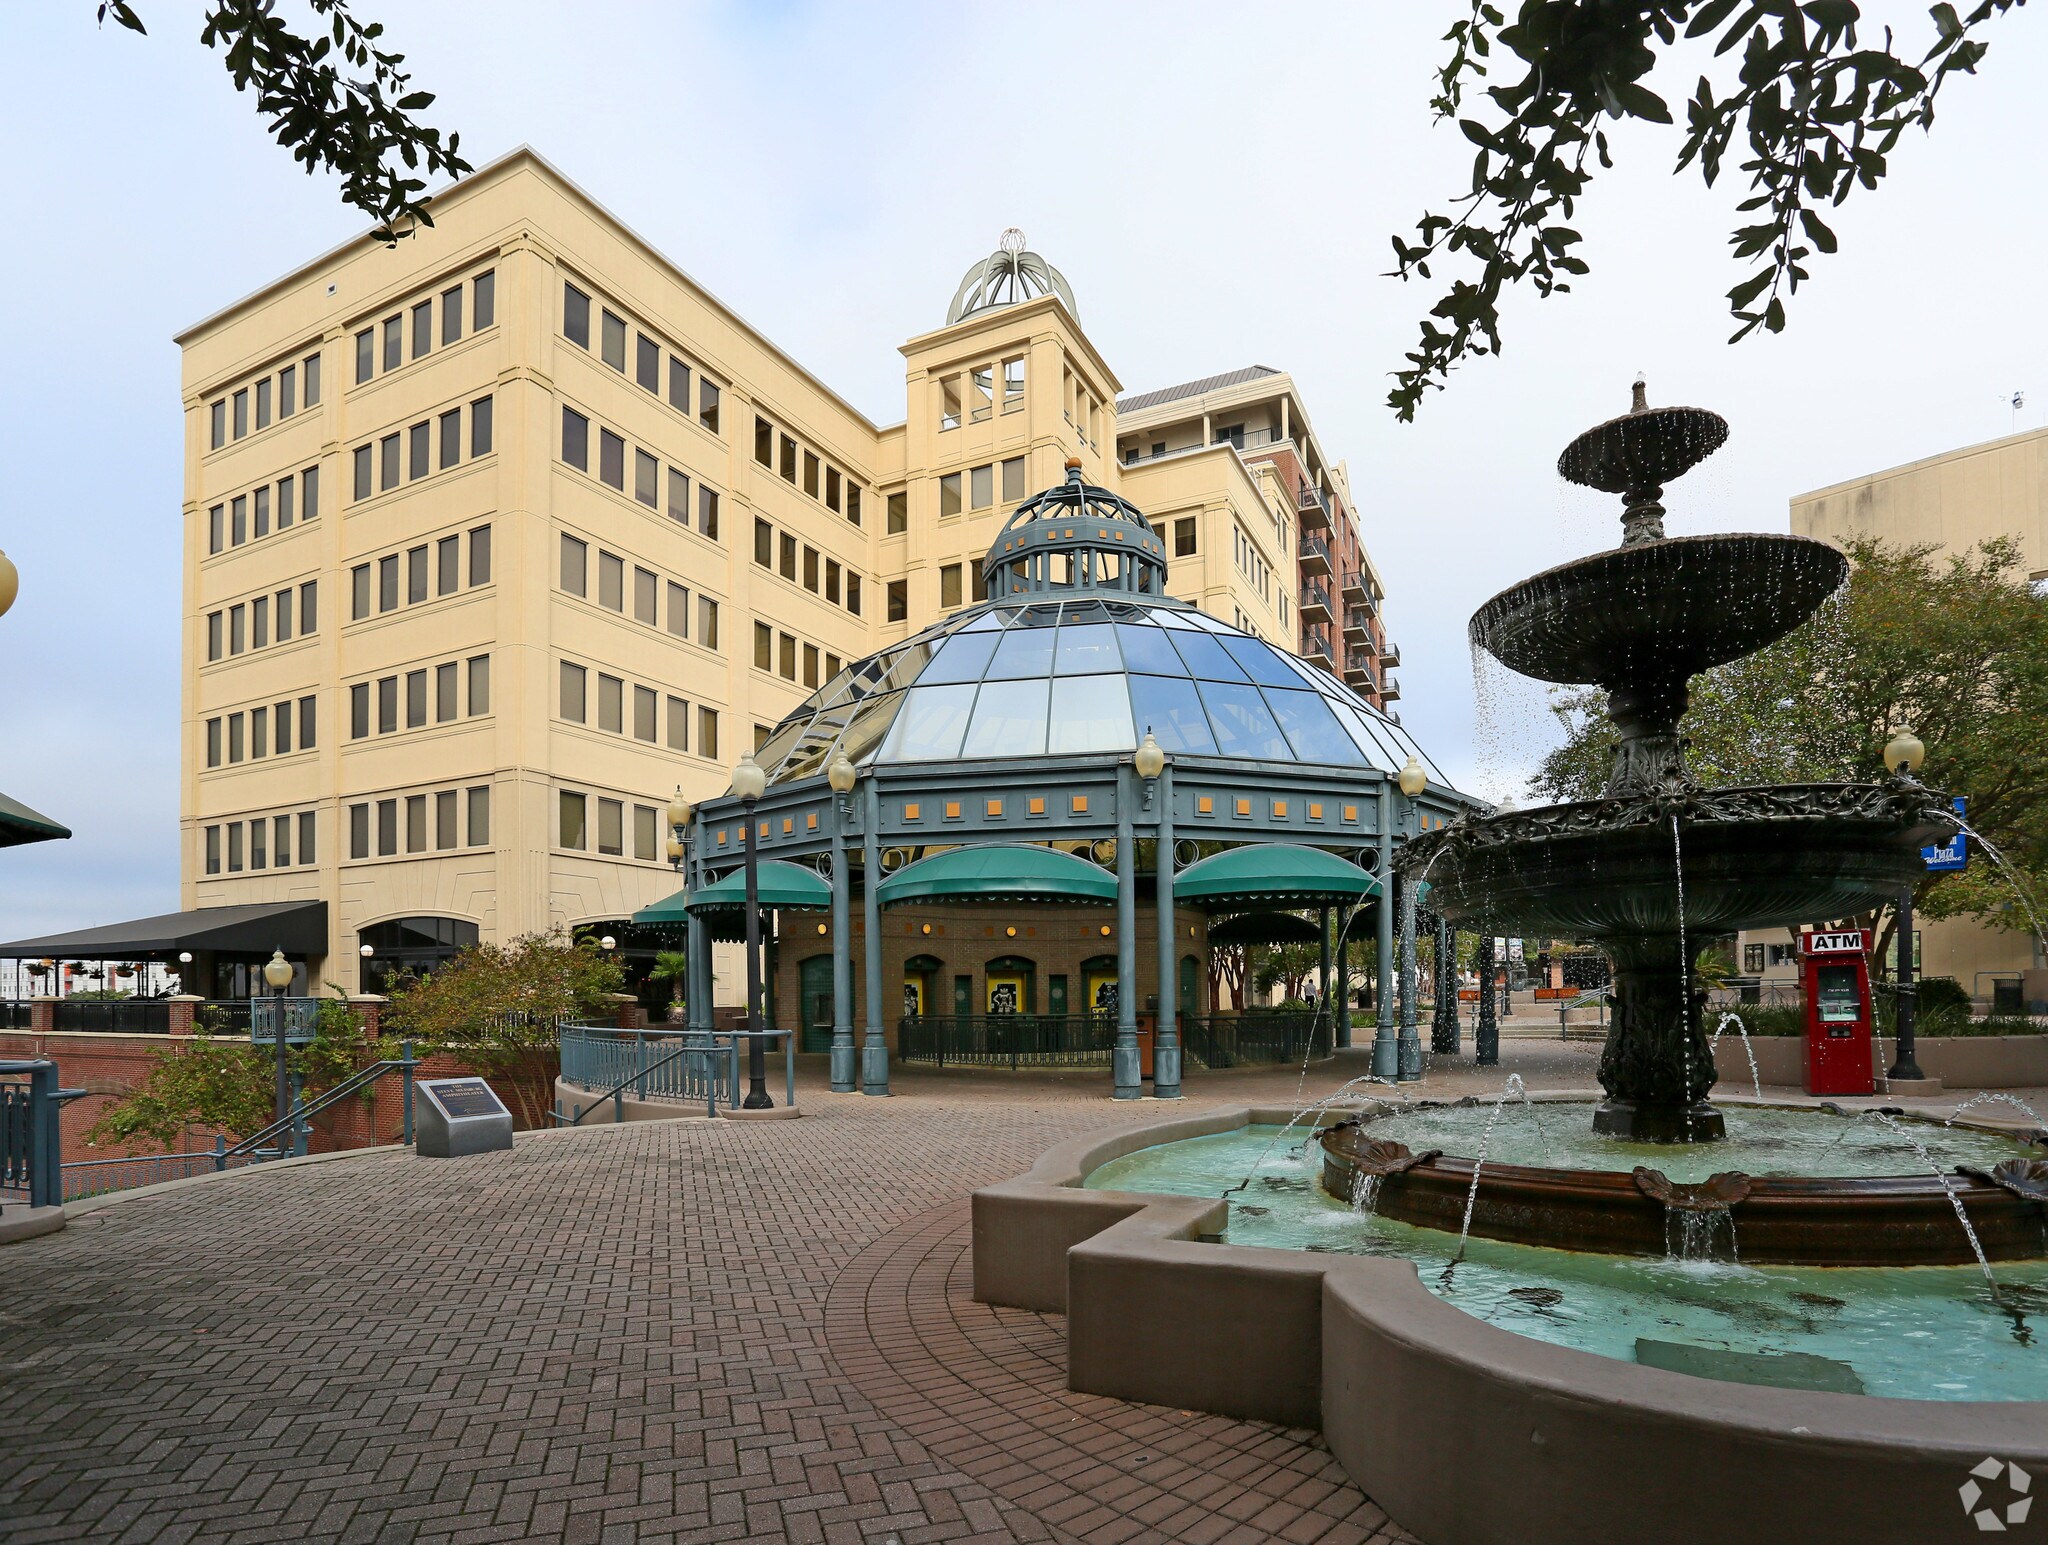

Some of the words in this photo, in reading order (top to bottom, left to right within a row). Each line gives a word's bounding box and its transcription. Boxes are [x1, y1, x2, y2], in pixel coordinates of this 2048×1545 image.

[1934, 846, 1954, 859] Plaza
[1924, 856, 1962, 864] Welcome
[1814, 934, 1860, 949] ATM
